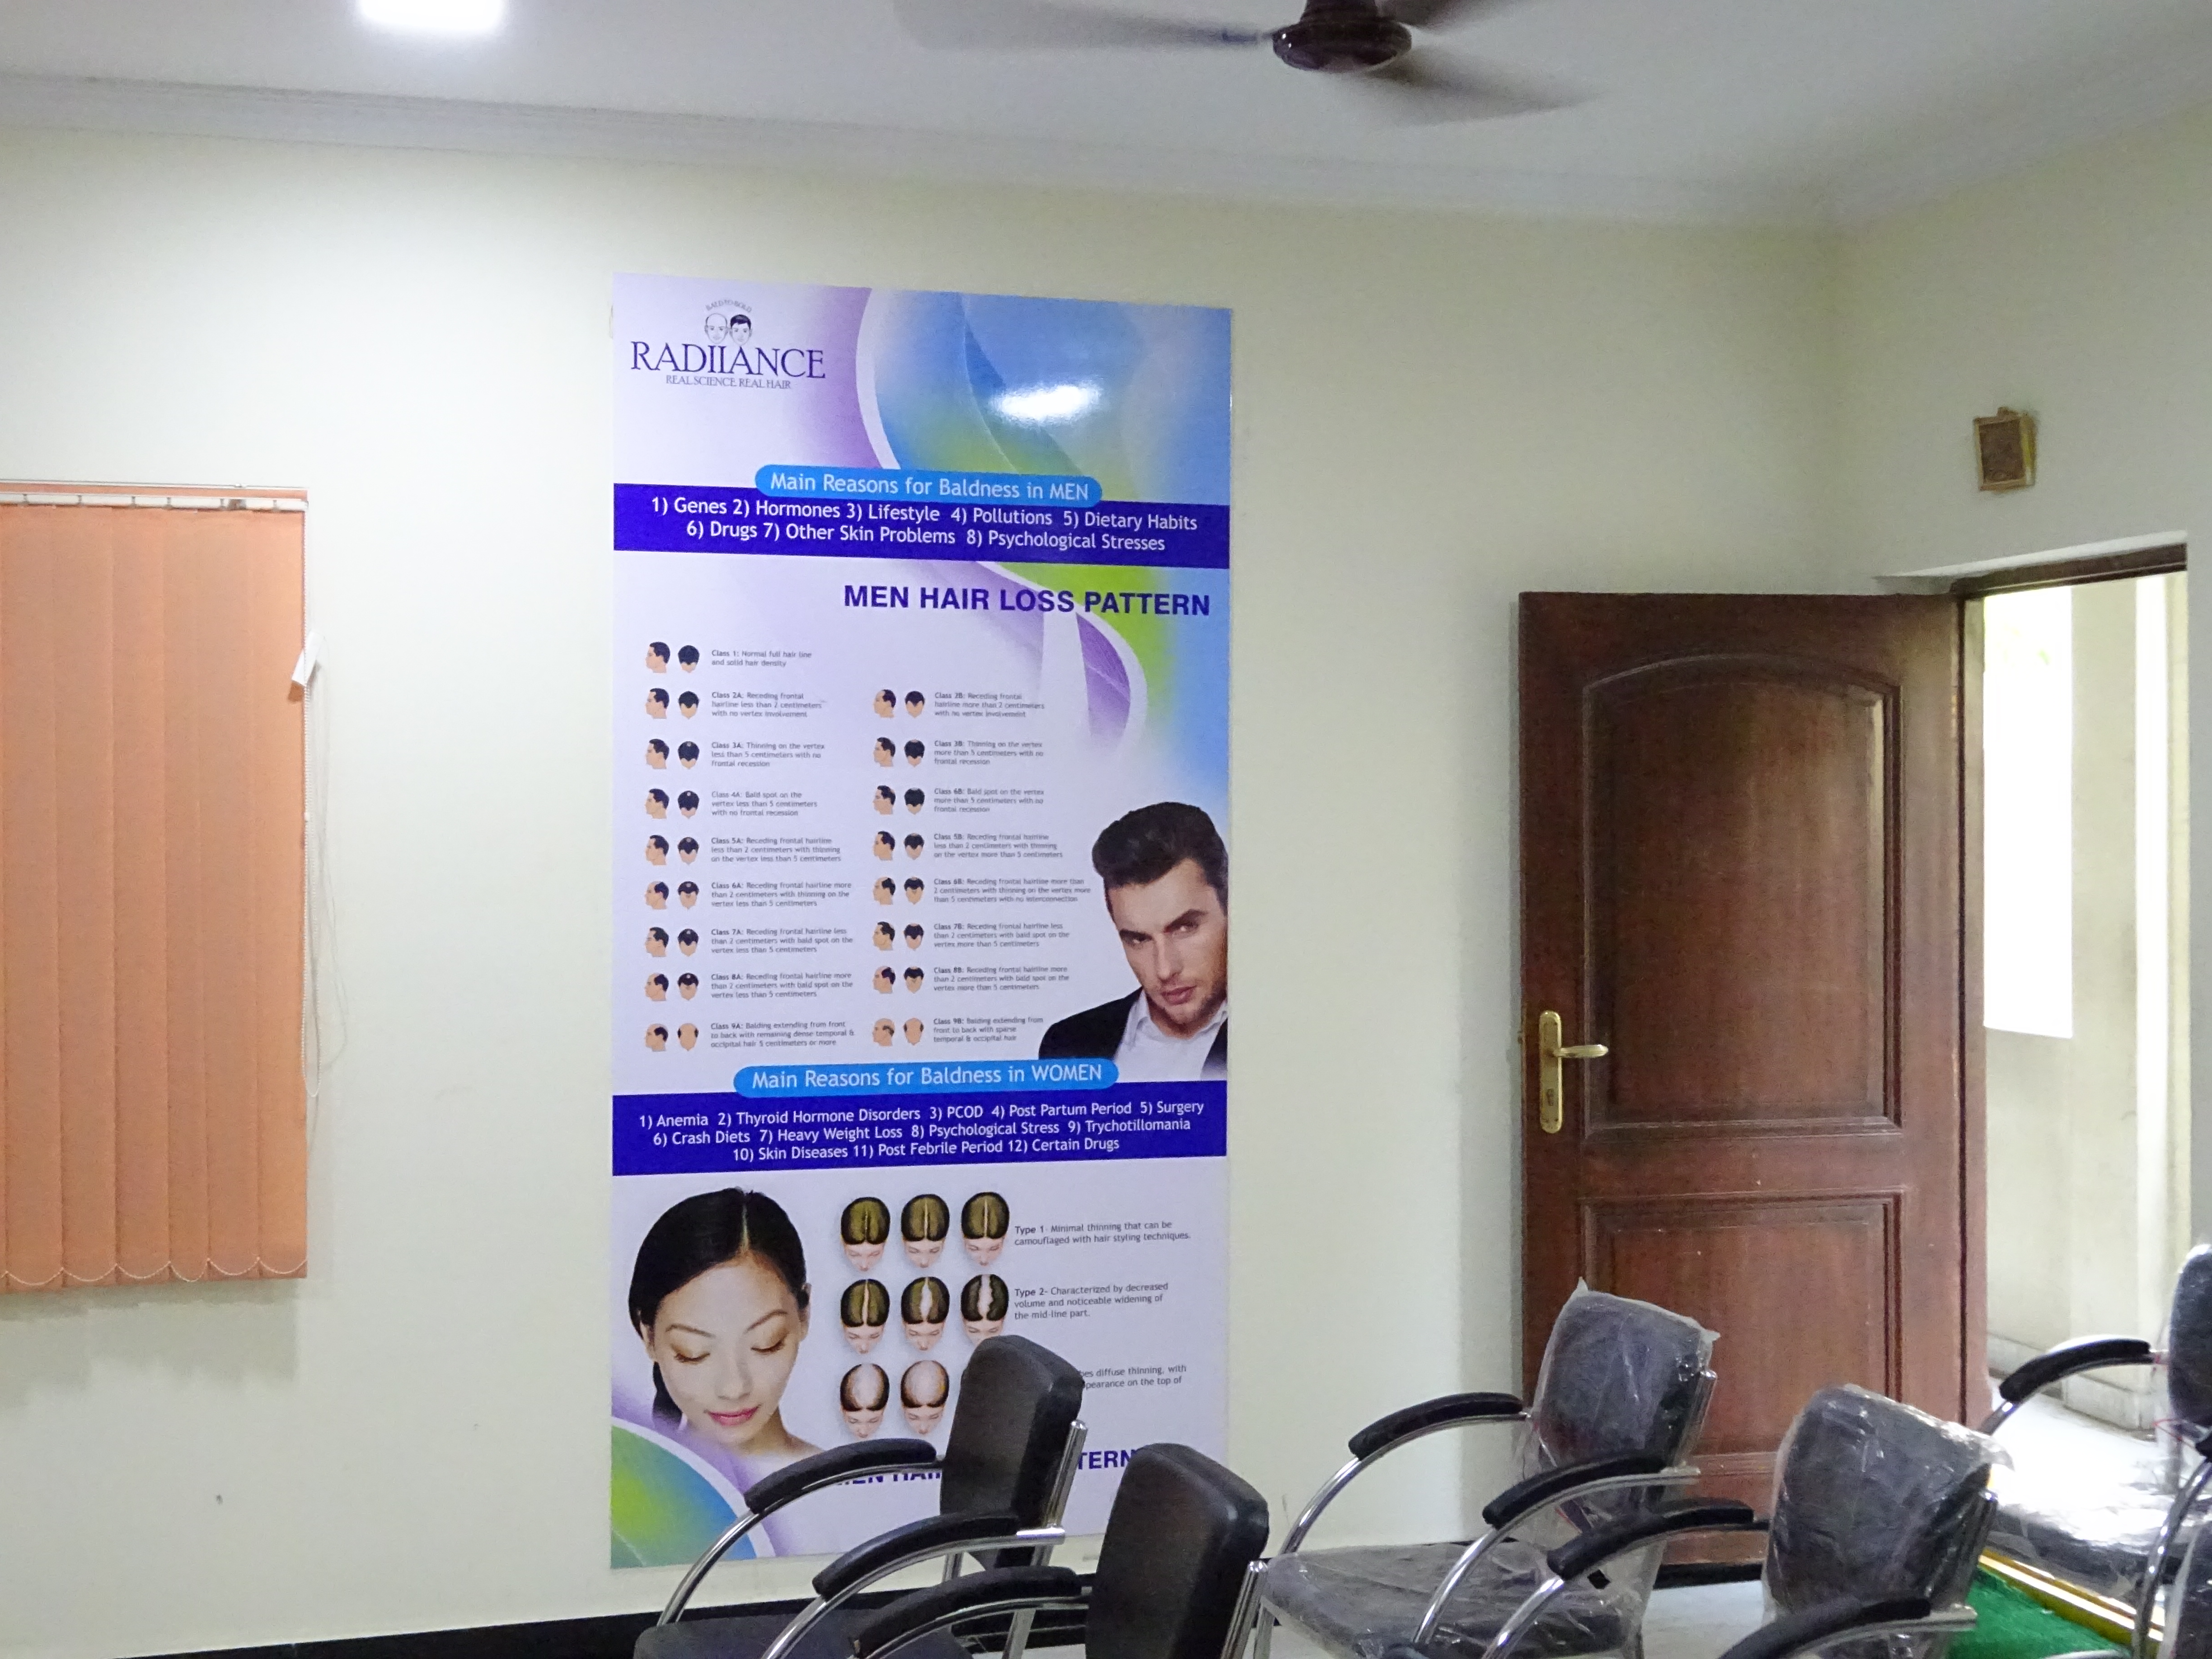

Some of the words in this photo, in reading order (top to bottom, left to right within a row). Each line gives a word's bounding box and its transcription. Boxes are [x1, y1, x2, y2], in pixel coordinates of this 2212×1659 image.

[631, 341, 825, 378] RADIIANCE
[666, 375, 692, 384] REAL
[694, 376, 736, 387] SCIENCE
[739, 378, 764, 388] REAL
[767, 380, 791, 389] HAIR
[771, 473, 815, 491] Main
[824, 474, 898, 493] Reasons
[905, 477, 932, 495] for
[940, 478, 1019, 498] Baldness
[1027, 483, 1043, 498] in
[1050, 483, 1087, 501] MEN
[653, 497, 668, 515] 1)
[674, 497, 726, 514] Genes
[733, 499, 749, 517] 2)
[756, 501, 840, 518] Hormones
[847, 503, 862, 521] 3)
[869, 504, 940, 521] Lifestyle
[951, 508, 966, 525] 4)
[974, 508, 1052, 525] Pollutions
[1064, 511, 1078, 528] 5)
[1085, 512, 1142, 528] Dietary
[1148, 514, 1197, 530] Habits
[687, 520, 703, 539] 6)
[711, 521, 757, 541] Drugs
[764, 522, 779, 541] 7)
[786, 524, 834, 540] Other
[840, 525, 873, 541] Skin
[881, 527, 955, 544] Problems
[967, 529, 982, 547] 8)
[989, 530, 1096, 551] Psychological
[1102, 534, 1165, 550] Stresses
[845, 585, 908, 608] MEN
[921, 587, 989, 609] HAIR
[1000, 589, 1074, 612] LOSS
[1085, 591, 1209, 615] PATTERN
[753, 1071, 797, 1088] Main
[806, 1069, 880, 1087] Reasons
[887, 1068, 913, 1085] for
[922, 1066, 1001, 1084] Baldness
[1009, 1066, 1024, 1082] in
[1032, 1064, 1101, 1082] WOMEN
[640, 1115, 652, 1129] 1)
[657, 1114, 708, 1126] Anemia
[718, 1113, 731, 1127] 2)
[737, 1111, 788, 1126] Thyroid
[793, 1111, 854, 1123] Hormone
[859, 1108, 920, 1120] Disorders
[930, 1107, 942, 1121] 3)
[947, 1106, 983, 1118] PCOD
[992, 1106, 1004, 1119] 4)
[1010, 1104, 1036, 1116] Post
[1041, 1104, 1087, 1116] Partum
[1092, 1102, 1131, 1114] Period
[1141, 1101, 1152, 1115] 5)
[1157, 1101, 1204, 1115] Surgery
[654, 1133, 667, 1147] 6)
[672, 1131, 710, 1144] Crash
[716, 1130, 750, 1143] Diets
[760, 1129, 773, 1144] 7)
[778, 1129, 819, 1143] Heavy
[824, 1127, 870, 1142] Weight
[875, 1126, 902, 1139] Loss
[912, 1125, 924, 1139] 8)
[929, 1123, 1016, 1139] Psychological
[1022, 1121, 1059, 1134] Stress
[1068, 1120, 1080, 1134] 9)
[1086, 1118, 1190, 1132] Trychotillomania
[734, 1148, 754, 1162] 10)
[759, 1147, 786, 1160] Skin
[792, 1146, 848, 1159] Diseases
[854, 1144, 873, 1158] 11)
[879, 1143, 905, 1156] Post
[911, 1142, 957, 1154] Febrile
[962, 1140, 1003, 1153] Period
[1009, 1139, 1027, 1153] 12)
[1032, 1138, 1079, 1151] Certain
[1085, 1137, 1119, 1152] Drugs
[1015, 1225, 1036, 1235] Type
[1087, 1223, 1121, 1233] thinning
[1015, 1236, 1069, 1245] camouflaged
[1114, 1234, 1140, 1243] styling
[1015, 1288, 1036, 1298] Type
[1040, 1287, 1047, 1295] 2-
[1051, 1285, 1110, 1295] Characterized
[1113, 1285, 1123, 1293] by
[1126, 1284, 1168, 1292] decreased
[1067, 1297, 1111, 1305] noticeable
[1115, 1296, 1152, 1304] widening
[1155, 1293, 1162, 1302] of
[1032, 1310, 1067, 1318] mid-line
[1096, 1368, 1125, 1377] diffuse
[1168, 1365, 1186, 1373] with
[1174, 1376, 1181, 1384] of
